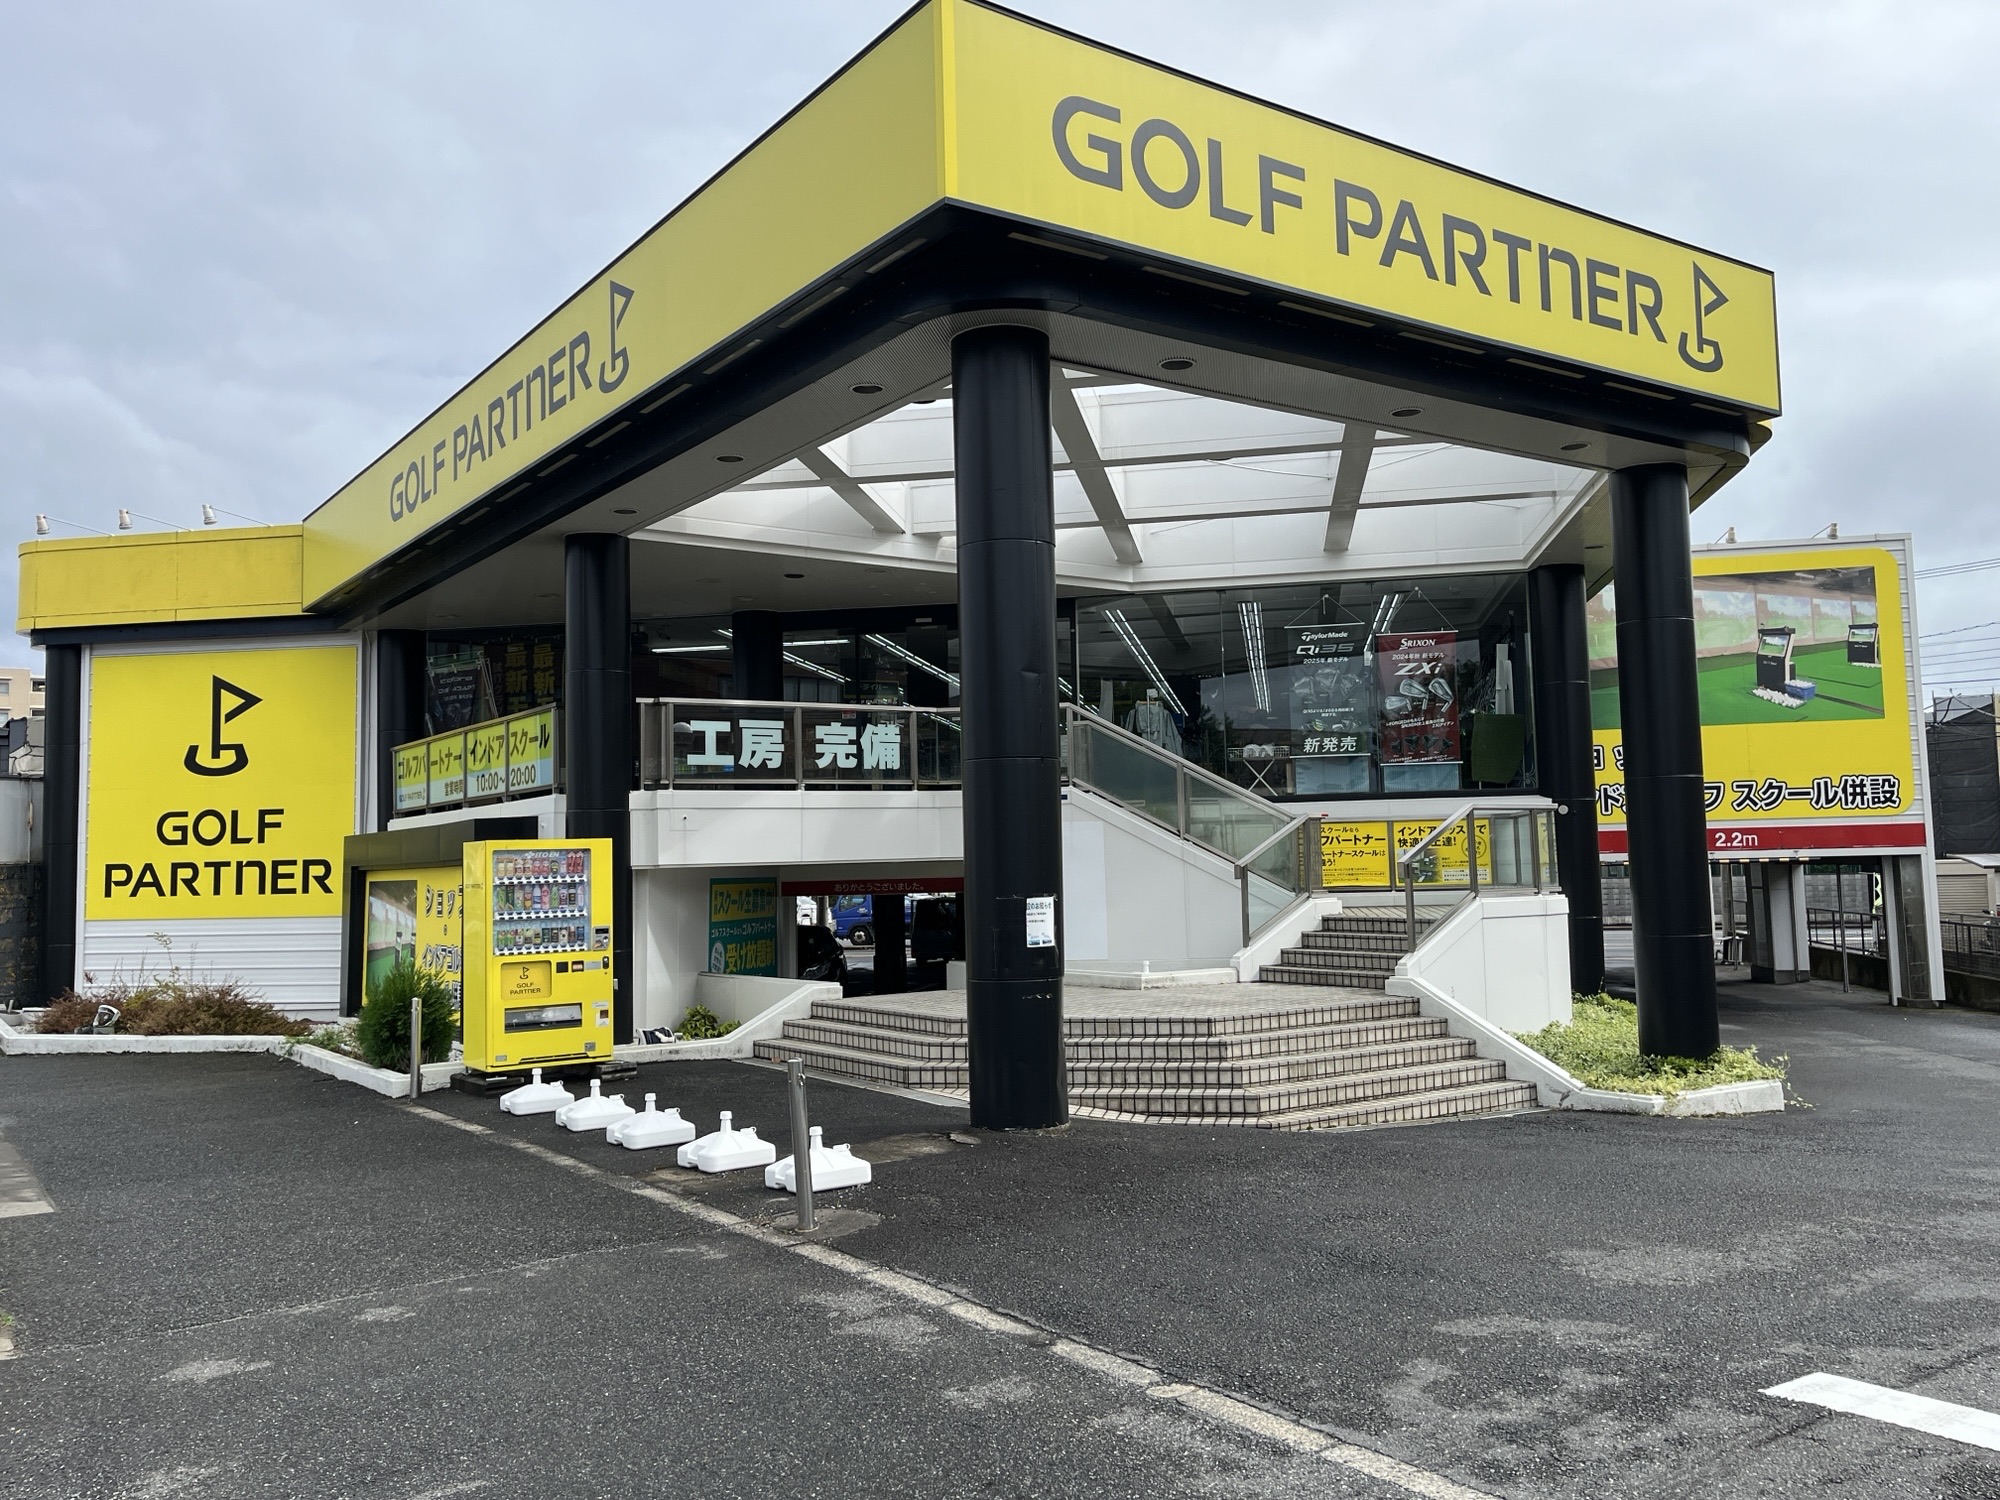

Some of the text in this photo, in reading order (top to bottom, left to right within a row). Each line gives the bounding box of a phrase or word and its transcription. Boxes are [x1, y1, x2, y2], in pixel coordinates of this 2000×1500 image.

[1051, 95, 1667, 344] GOLF PARTNER
[390, 330, 593, 523] GOLF PARTNER
[1301, 632, 1348, 642] TaylorMade
[1400, 638, 1436, 650] SRIXON
[1296, 643, 1354, 655] Qi35
[1394, 662, 1442, 675] ZXi
[686, 719, 901, 770] 工房 完備
[1303, 736, 1357, 753] 新発売
[156, 808, 285, 847] GOLF
[1714, 832, 1759, 847] 2.2m
[104, 859, 333, 898] PARTNER
